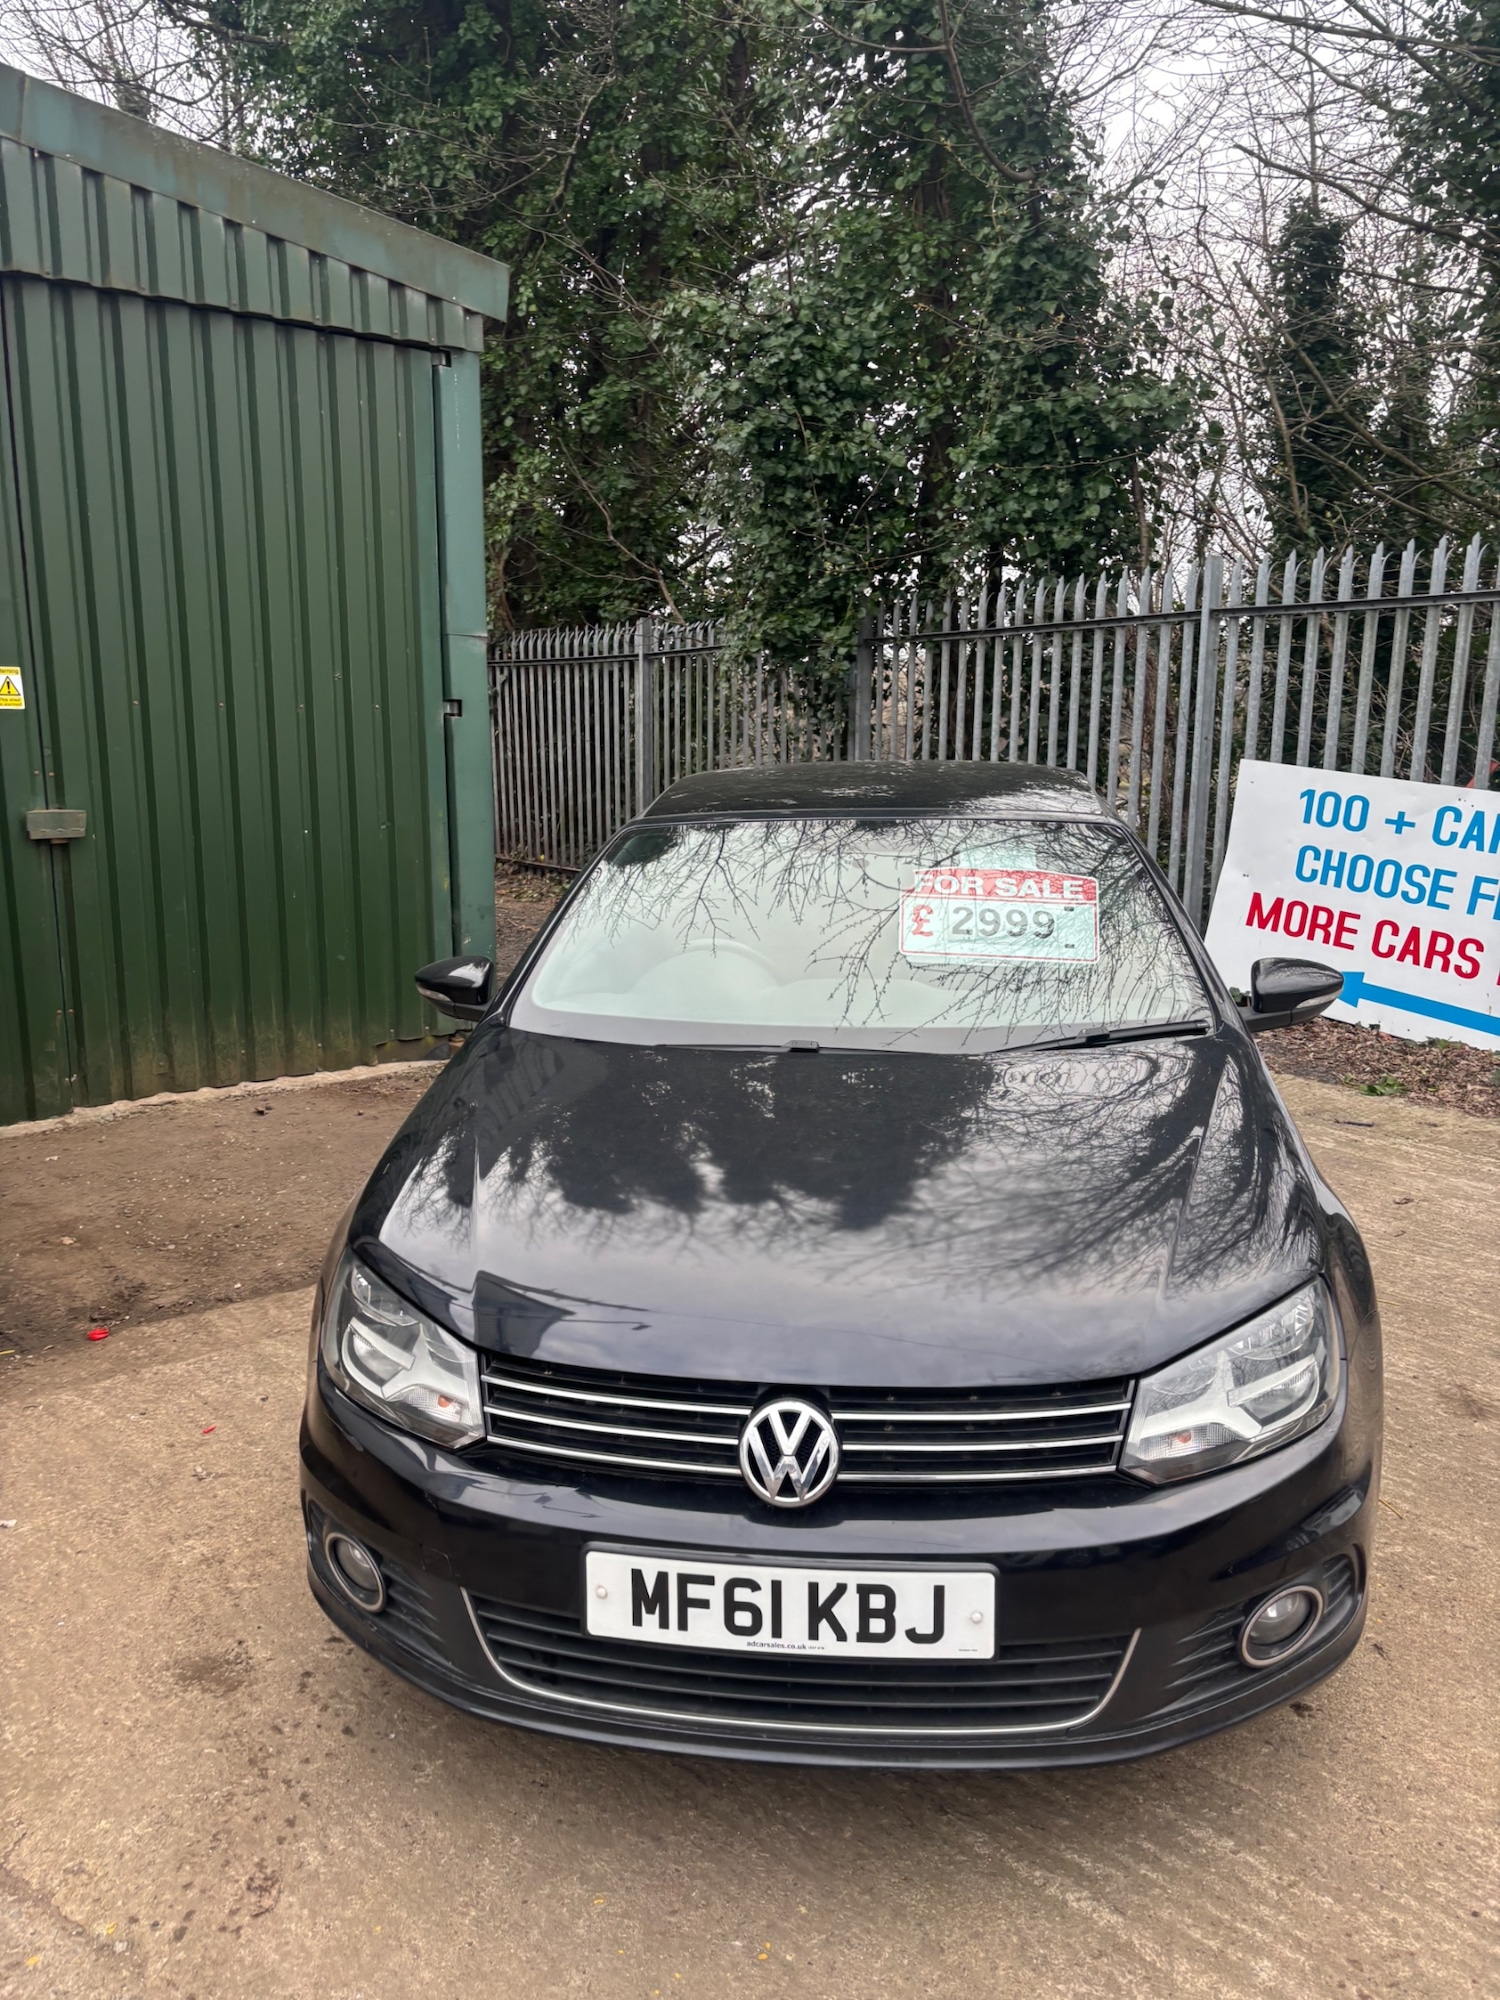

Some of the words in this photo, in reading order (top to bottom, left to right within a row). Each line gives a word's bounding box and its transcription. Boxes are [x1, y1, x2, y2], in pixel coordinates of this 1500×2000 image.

[1299, 789, 1370, 832] 100
[914, 873, 984, 895] FOR
[995, 877, 1084, 900] SALE
[1295, 845, 1458, 910] CHOOSE
[1466, 874, 1500, 921] F
[911, 904, 934, 937] £
[951, 906, 1055, 939] 2999
[1245, 892, 1361, 950] MORE
[1371, 919, 1485, 980] CARS
[743, 1402, 836, 1503] VW
[630, 1567, 783, 1639] MF61
[807, 1581, 946, 1645] KBJ
[746, 1640, 807, 1650] adcarsales.co.uk
